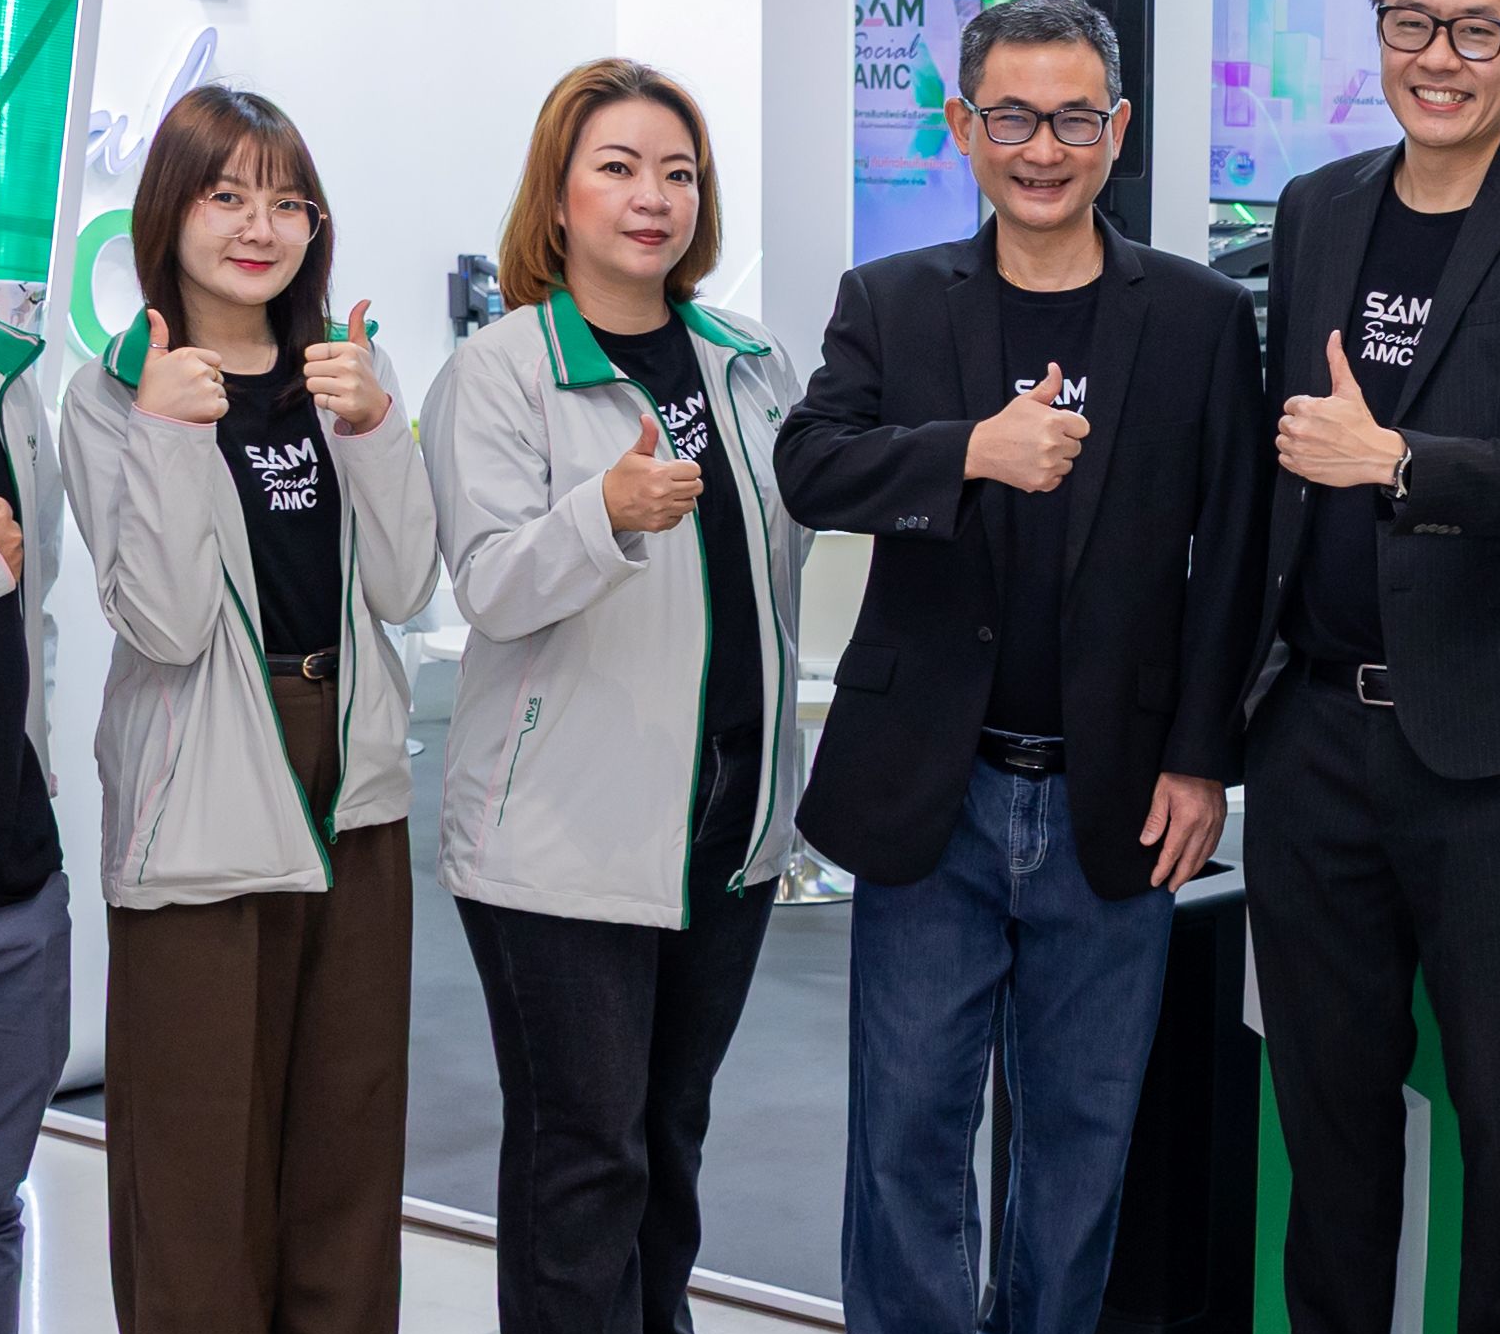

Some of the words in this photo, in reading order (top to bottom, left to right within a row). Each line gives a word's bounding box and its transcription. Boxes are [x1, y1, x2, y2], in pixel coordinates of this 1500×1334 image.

[855, 64, 911, 91] AMC
[1362, 291, 1433, 325] SAM
[1362, 321, 1423, 346] Social
[1361, 340, 1414, 366] AMC
[245, 437, 319, 470] SAM
[261, 465, 319, 492] Social
[270, 488, 318, 511] AMC
[524, 697, 539, 723] SAM
